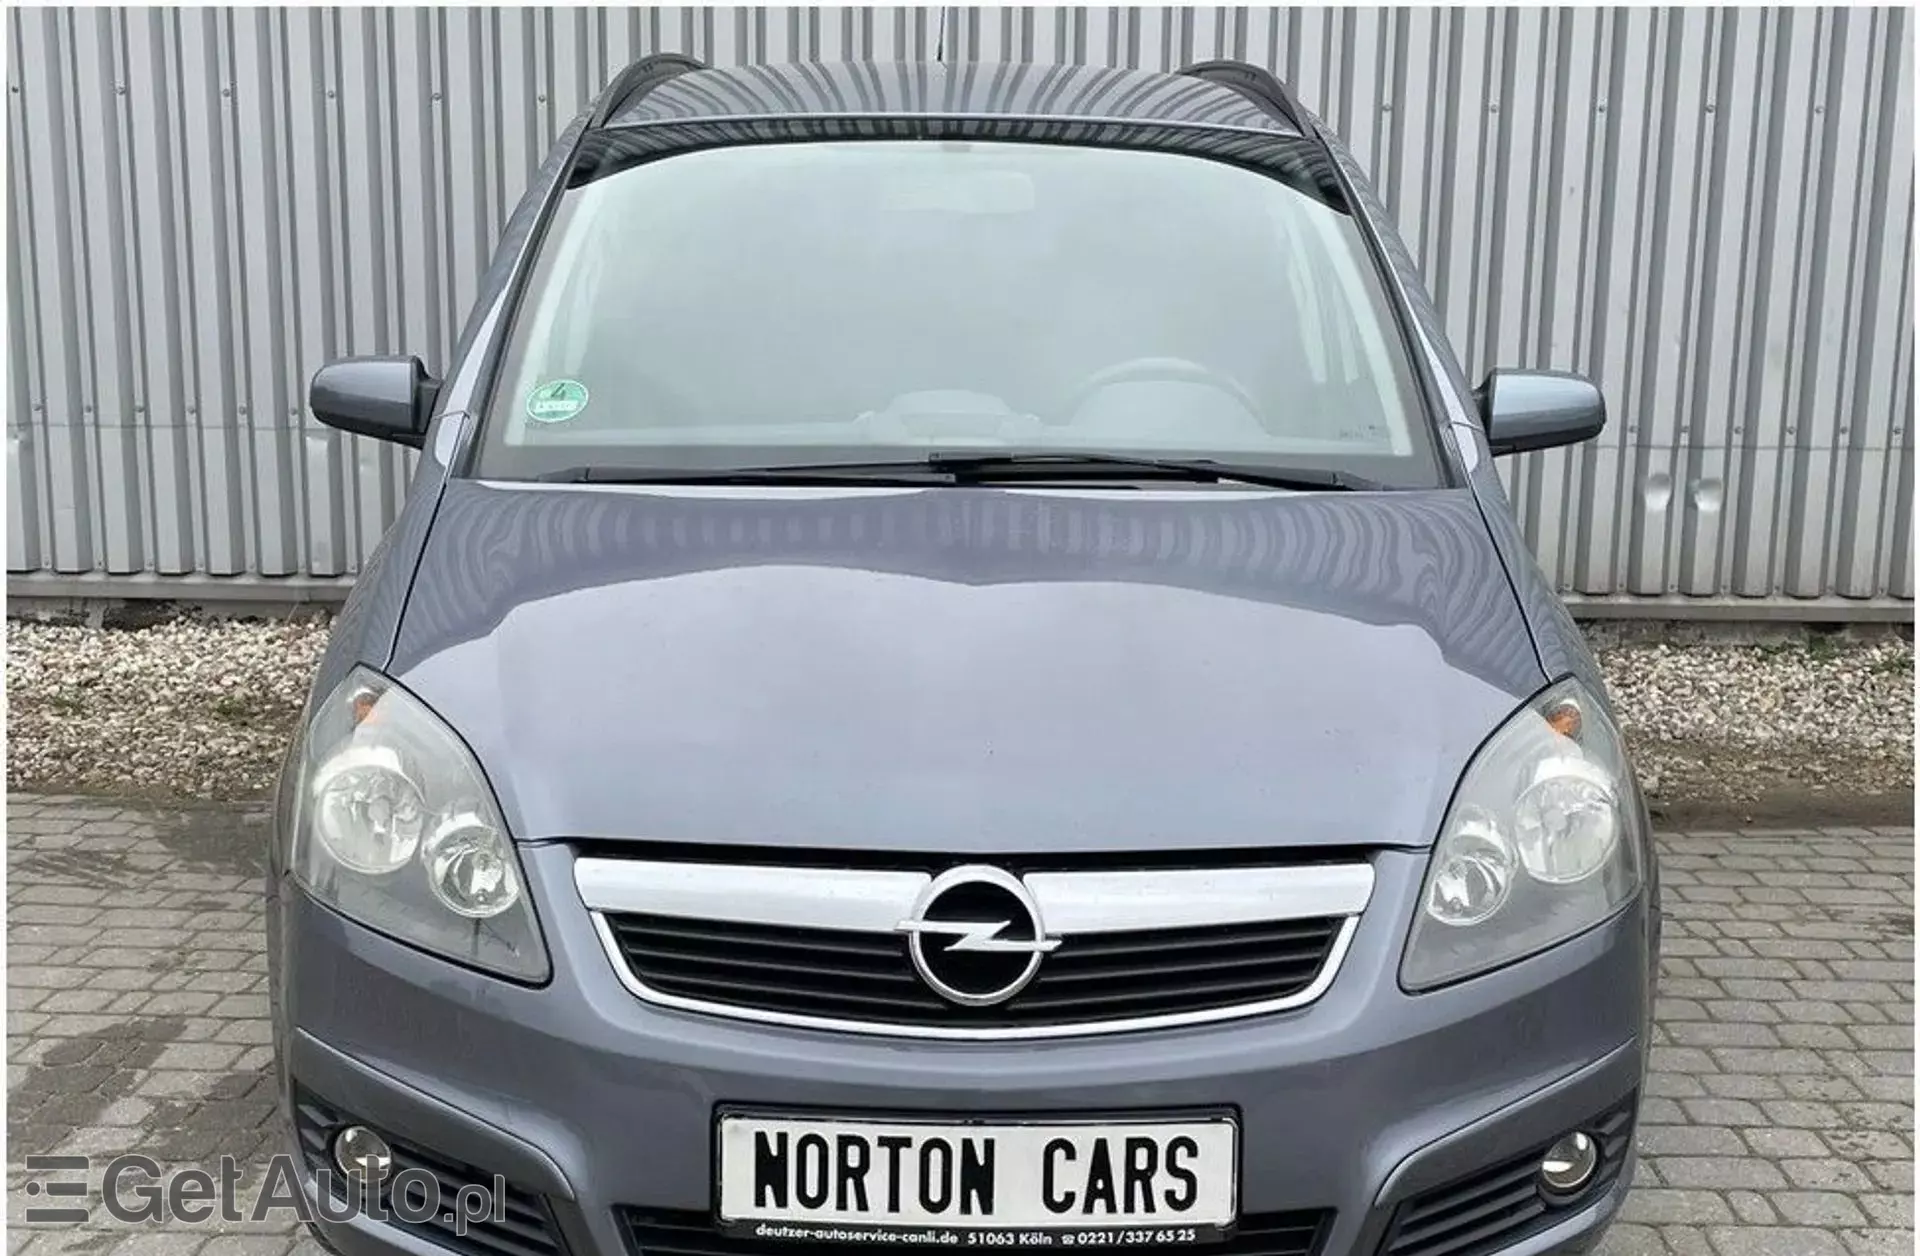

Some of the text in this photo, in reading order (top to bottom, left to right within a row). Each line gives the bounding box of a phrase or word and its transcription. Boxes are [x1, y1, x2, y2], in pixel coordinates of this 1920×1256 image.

[754, 1131, 1199, 1215] NORTON CARS
[755, 1223, 959, 1244] deutzer-autoservice-canli.de
[967, 1231, 1015, 1245] 51063
[1019, 1231, 1053, 1245] Köln
